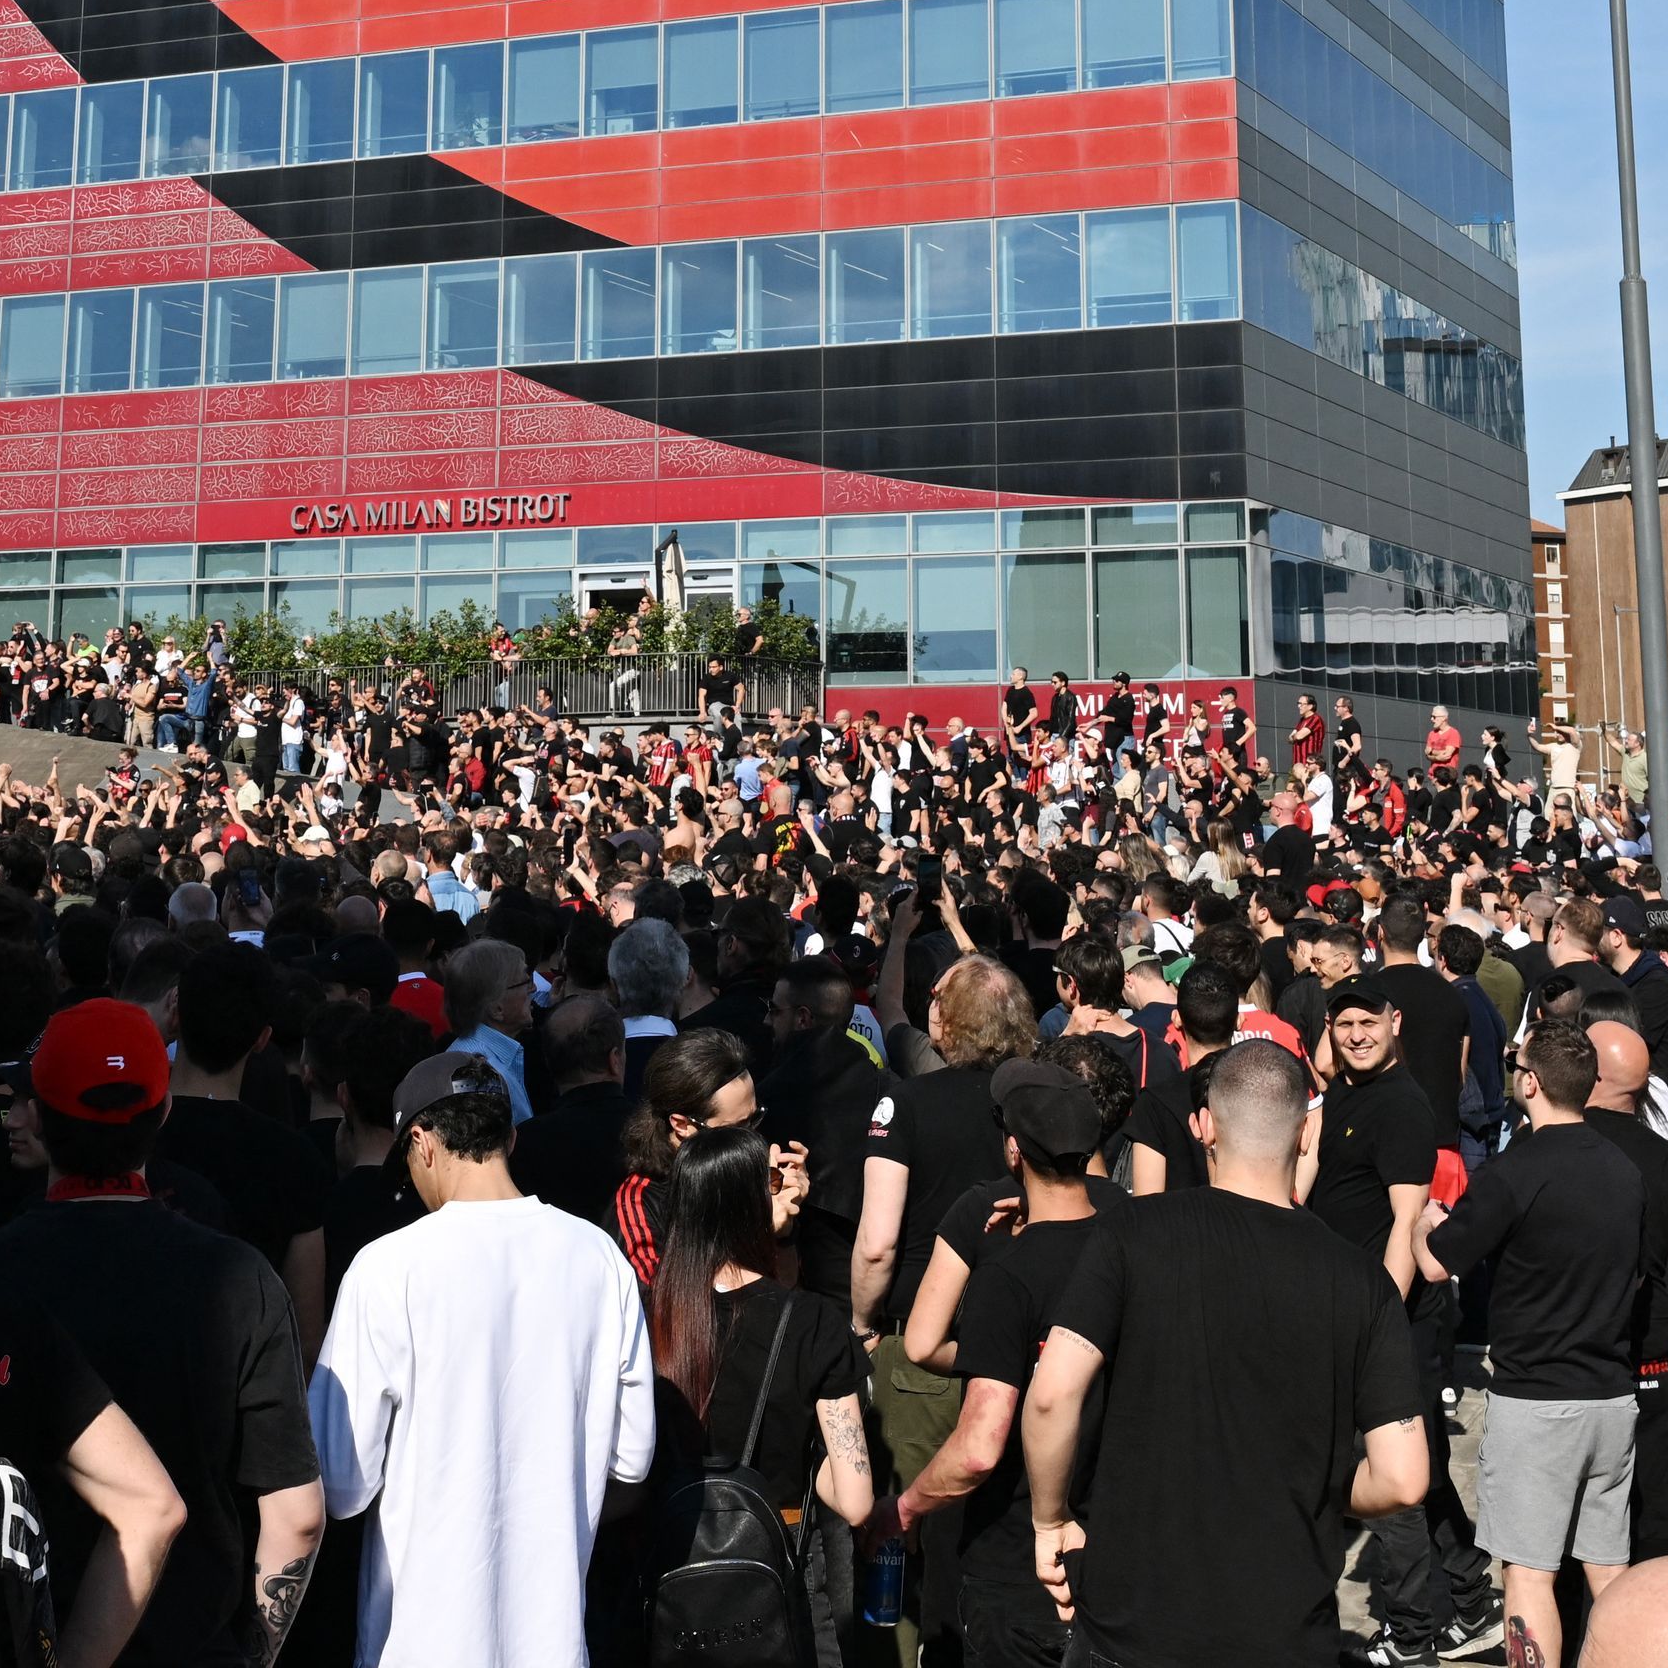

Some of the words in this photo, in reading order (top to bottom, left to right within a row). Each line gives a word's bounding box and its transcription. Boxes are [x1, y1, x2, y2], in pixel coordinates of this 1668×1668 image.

[290, 503, 356, 532] CASA
[365, 498, 452, 527] MILAN
[460, 492, 572, 524] BISTROT
[1075, 693, 1184, 717] MEM
